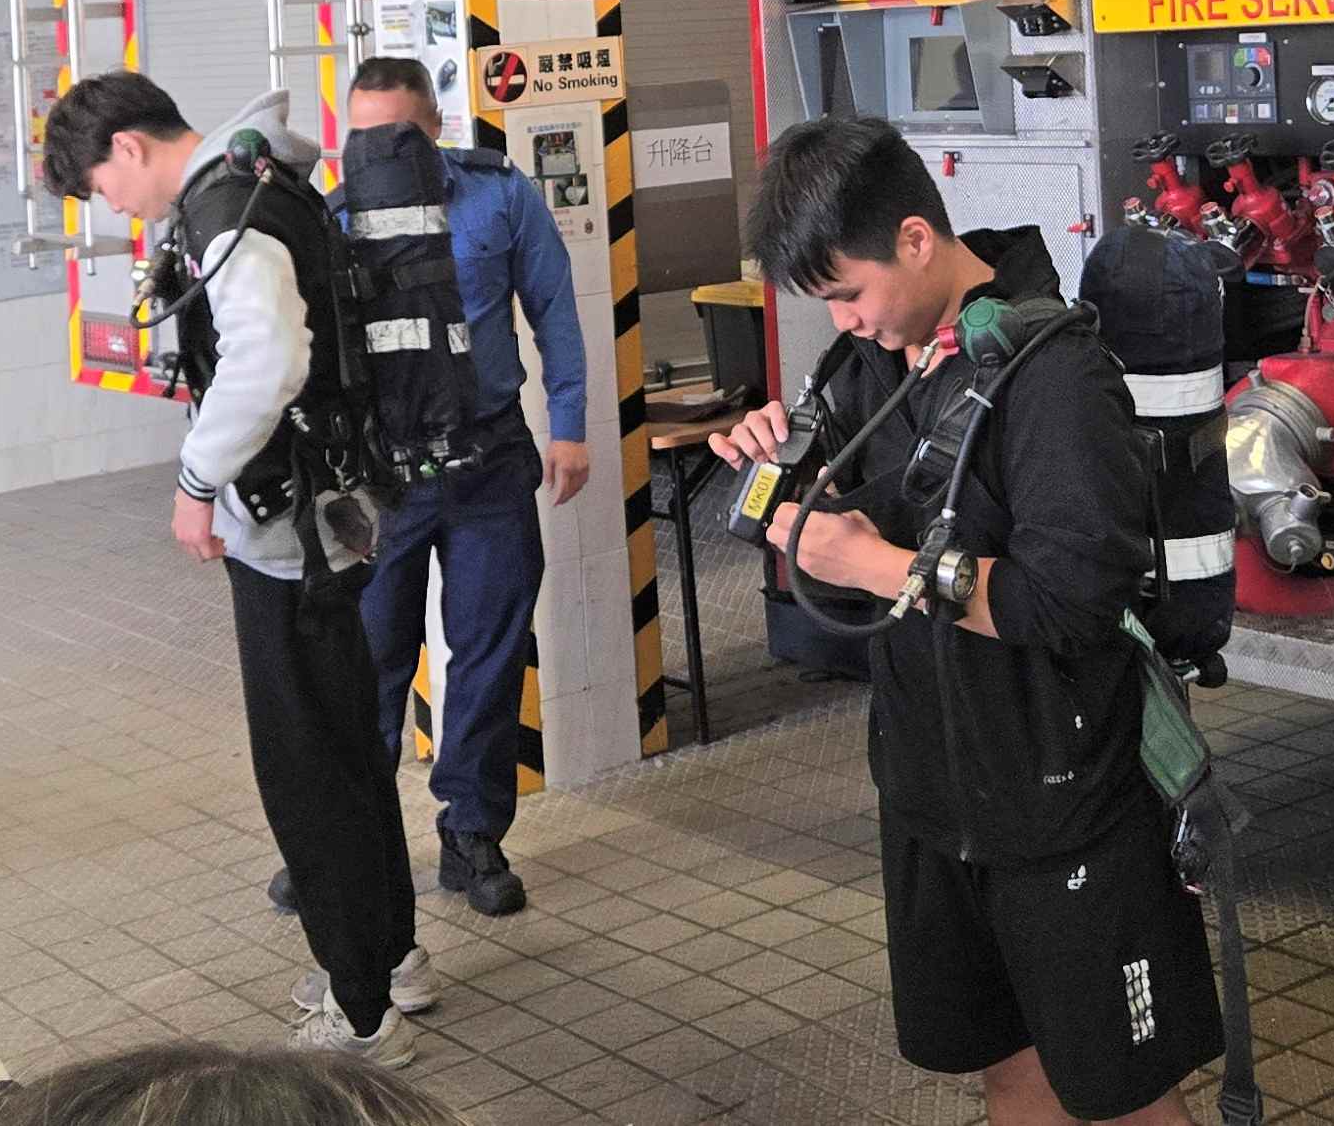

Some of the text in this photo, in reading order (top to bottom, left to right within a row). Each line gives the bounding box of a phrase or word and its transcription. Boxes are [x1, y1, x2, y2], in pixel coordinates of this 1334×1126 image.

[533, 73, 619, 93] No Smoking
[646, 134, 713, 169] 升降台
